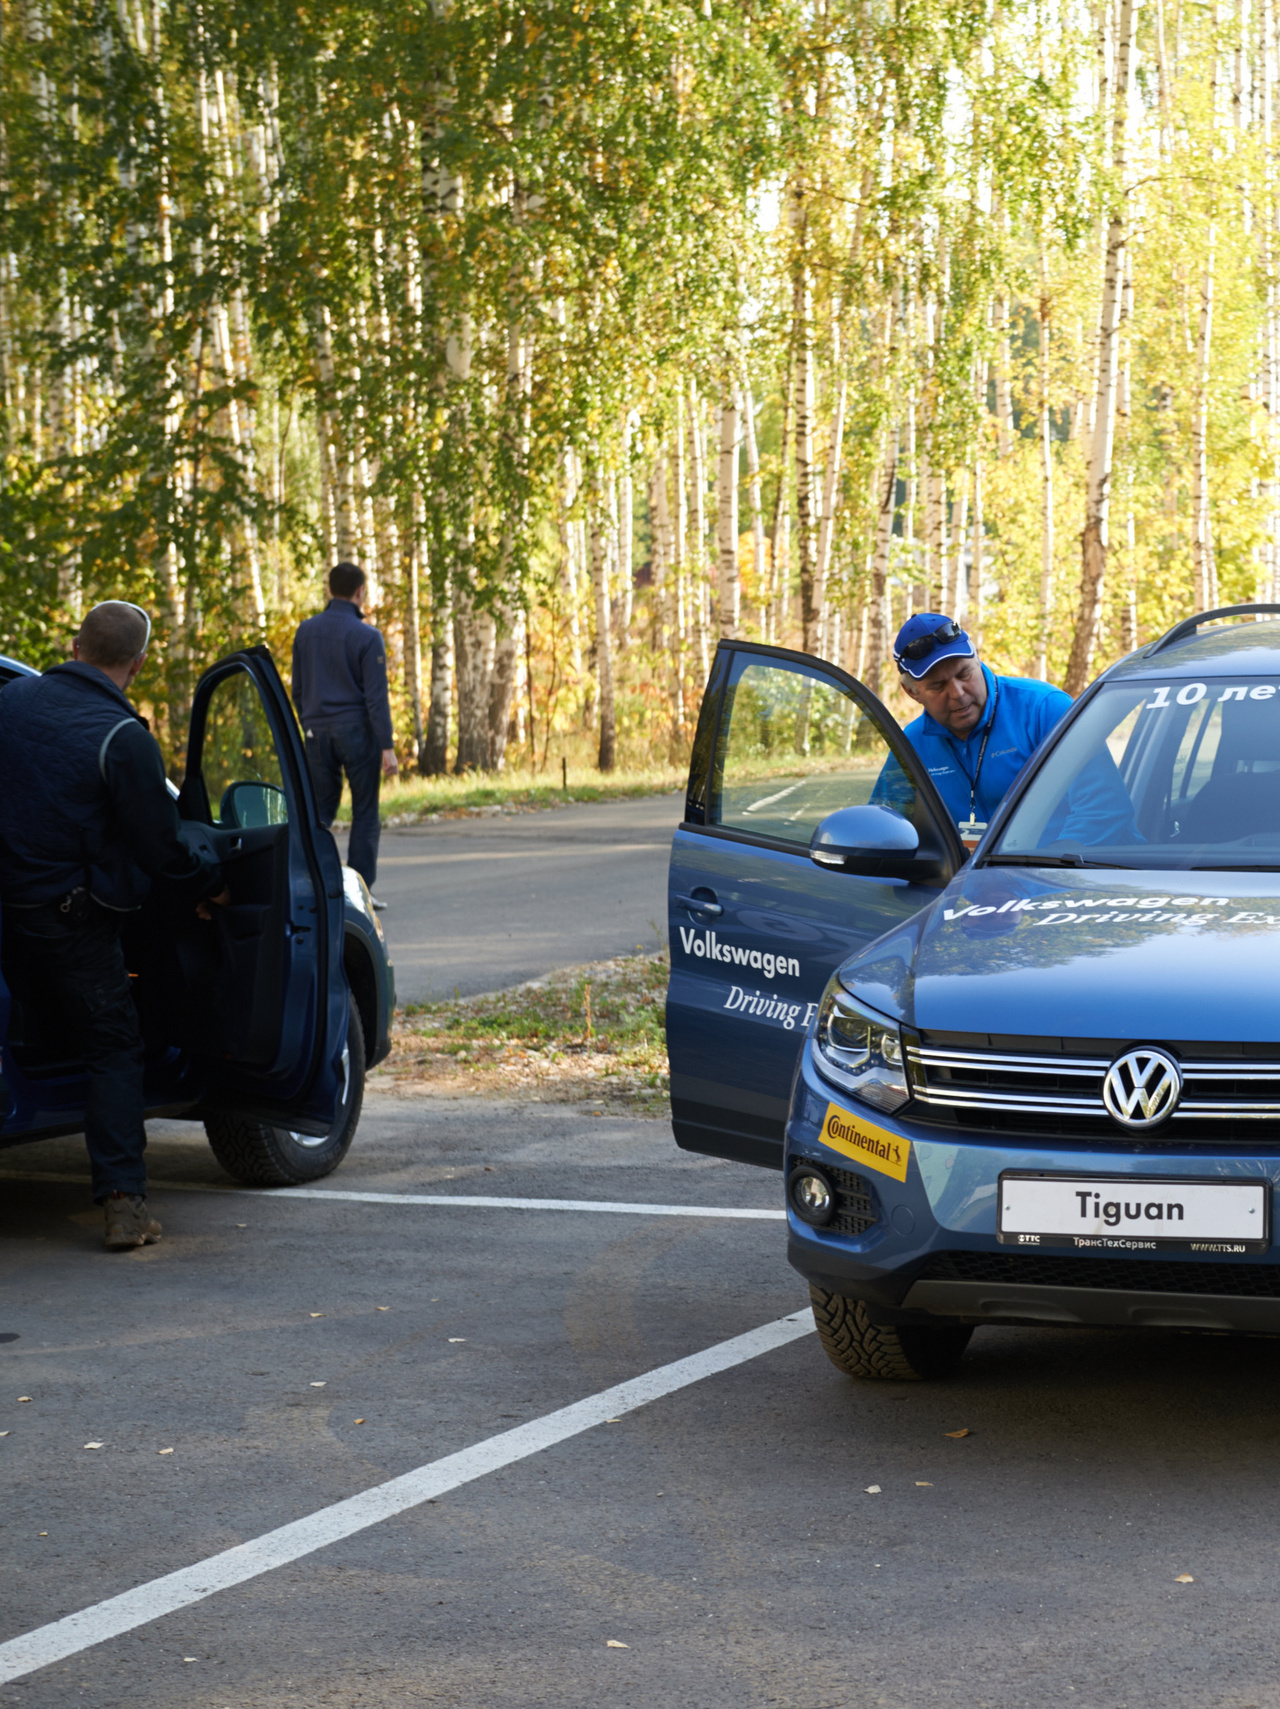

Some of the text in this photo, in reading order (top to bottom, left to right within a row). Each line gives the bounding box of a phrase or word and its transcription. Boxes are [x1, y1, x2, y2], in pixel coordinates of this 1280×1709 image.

[1145, 683, 1207, 709] 10
[943, 897, 1230, 921] Volkswagen
[1033, 911, 1220, 926] Driving
[679, 926, 800, 978] Volkswagen
[724, 986, 802, 1030] Driving
[827, 1114, 891, 1161] Continental
[1075, 1191, 1184, 1226] Tiguan
[1073, 1237, 1157, 1251] ТрансТехСервис
